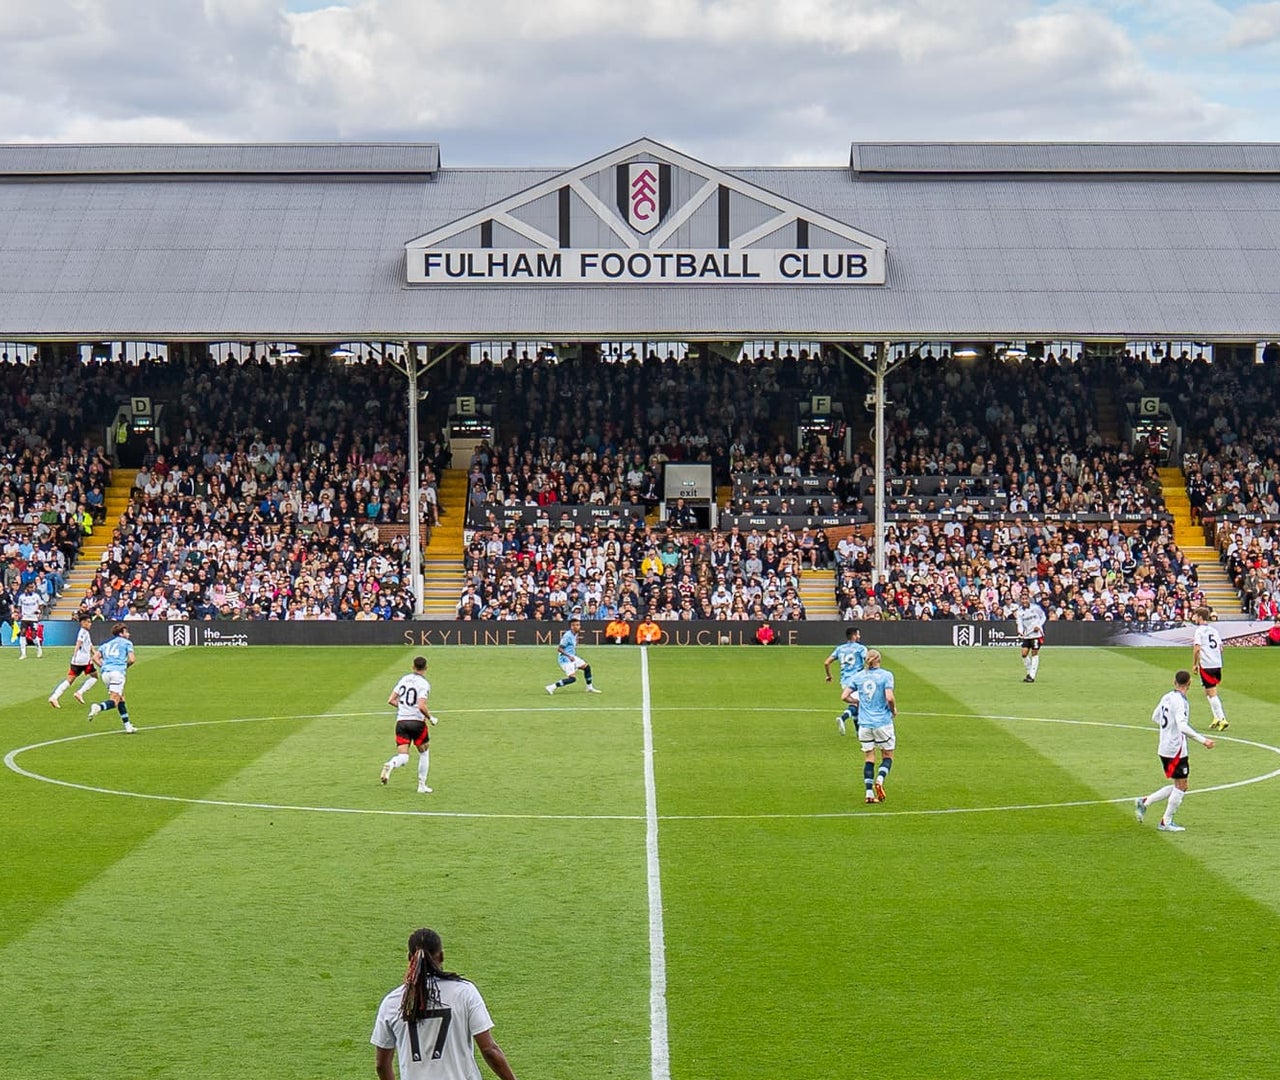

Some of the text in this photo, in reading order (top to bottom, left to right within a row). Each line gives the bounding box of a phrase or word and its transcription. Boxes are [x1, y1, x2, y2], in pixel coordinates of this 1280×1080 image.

[424, 253, 868, 278] FULHAM FOOTBALL CLUB
[135, 400, 146, 412] D
[461, 399, 470, 411] E
[817, 398, 826, 410] F
[1144, 400, 1156, 412] G
[680, 488, 697, 497] exit
[203, 628, 220, 639] the
[404, 630, 517, 646] SKYLINE
[988, 628, 1005, 639] the
[1208, 634, 1218, 649] 5
[105, 643, 120, 656] 14
[399, 685, 417, 707] 20
[863, 680, 876, 703] 9
[405, 1008, 452, 1062] 17
